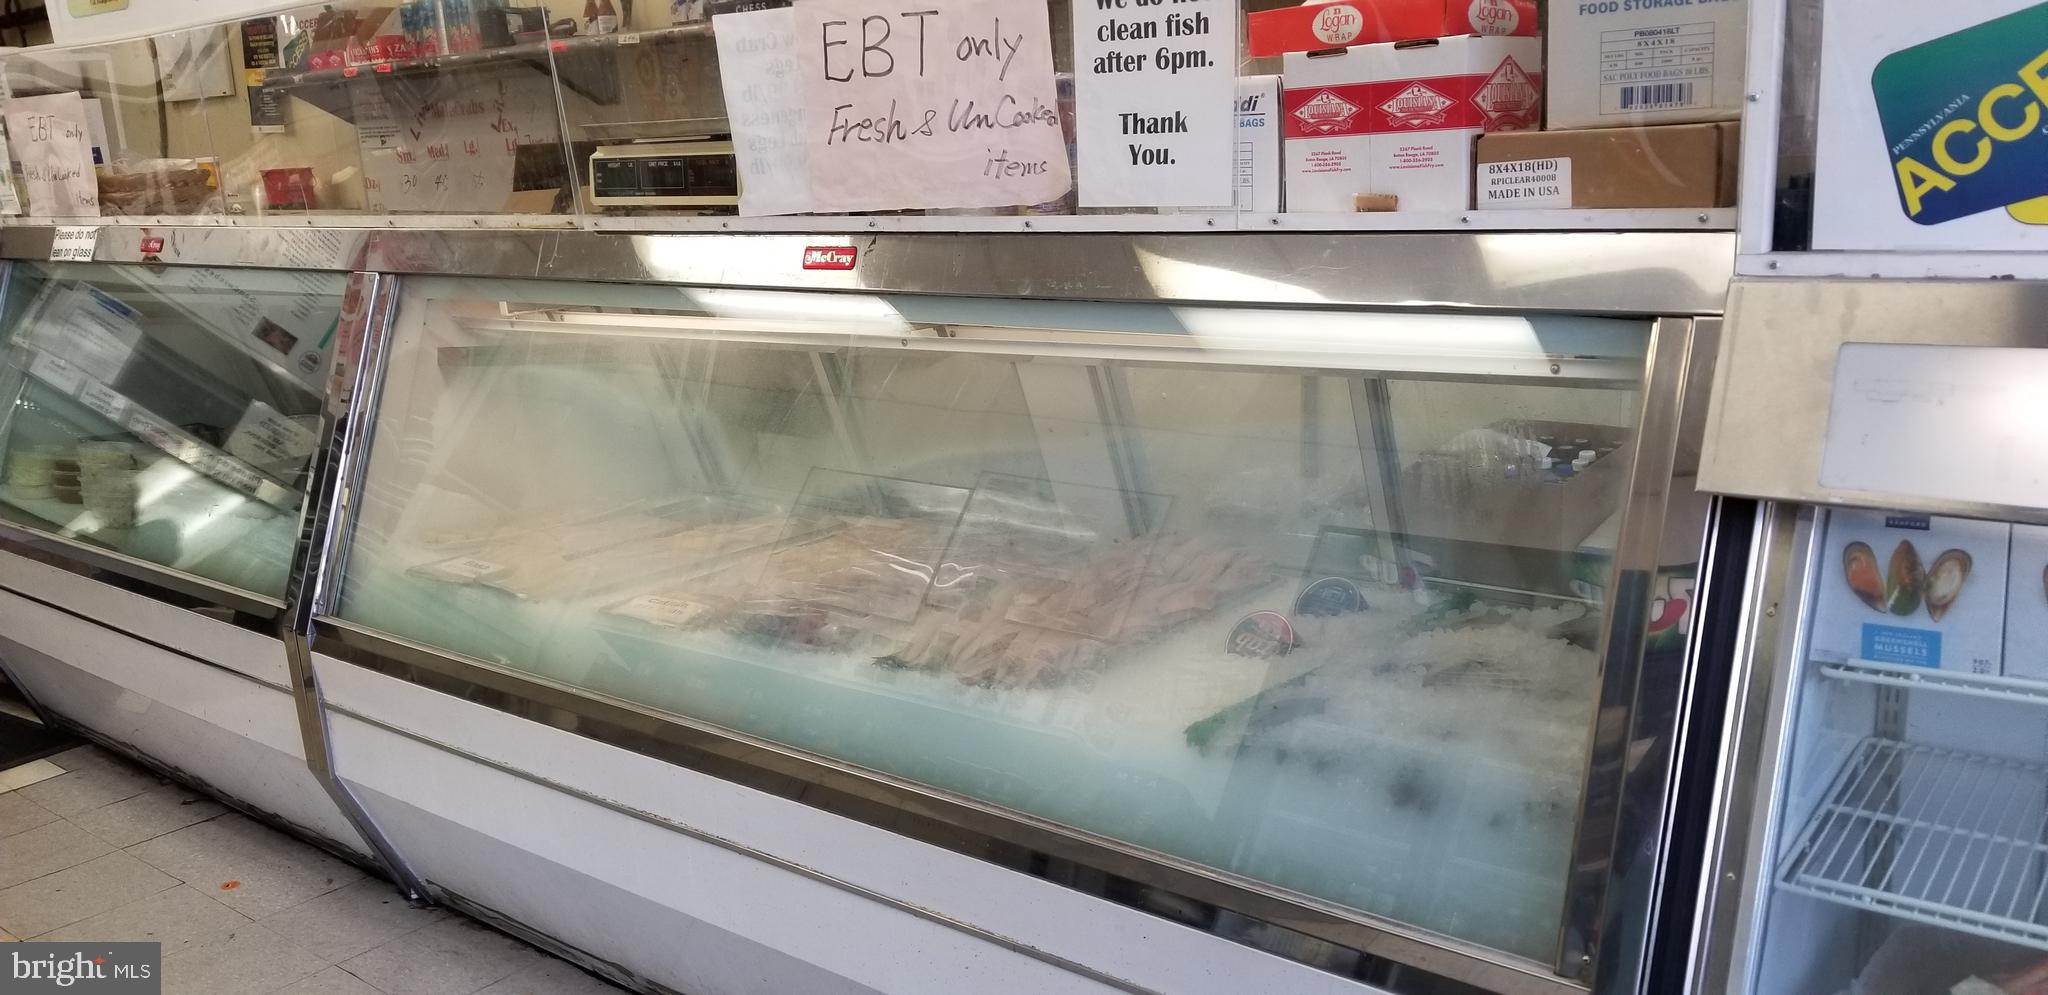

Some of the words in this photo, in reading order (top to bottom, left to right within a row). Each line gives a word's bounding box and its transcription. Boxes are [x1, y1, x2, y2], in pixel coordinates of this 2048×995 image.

[736, 2, 767, 13] CHESS
[1475, 0, 1512, 24] Logan
[1578, 2, 1619, 16] FOOD
[1097, 18, 1157, 42] clean
[1165, 11, 1210, 37] fish
[1319, 9, 1356, 31] Logan
[1326, 32, 1353, 41] WRAP
[1480, 24, 1507, 34] WRAP
[821, 10, 939, 83] EBT
[956, 17, 1023, 81] only
[1093, 50, 1147, 75] after
[1155, 47, 1214, 75] 6pm.
[1302, 102, 1349, 119] LOUISIANA
[1392, 95, 1442, 113] LOUISIANA
[28, 115, 56, 142] EBT
[66, 123, 83, 142] only
[828, 99, 907, 145] Fresh
[1118, 110, 1189, 135] Thank
[1239, 117, 1265, 128] BAGS
[1892, 93, 1971, 155] PENNSYLVANIA
[1128, 143, 1176, 166] You.
[983, 148, 1048, 179] items
[1488, 159, 1558, 175] 8X4X18(HD)
[1488, 187, 1521, 200] MADE
[1523, 187, 1535, 198] IN
[1538, 185, 1560, 196] USA
[55, 229, 74, 240] Please
[75, 228, 84, 240] do
[86, 228, 97, 240] not
[64, 248, 72, 257] on
[72, 246, 92, 260] glass
[811, 250, 855, 266] McCray
[1873, 643, 1928, 657] MUSSELS
